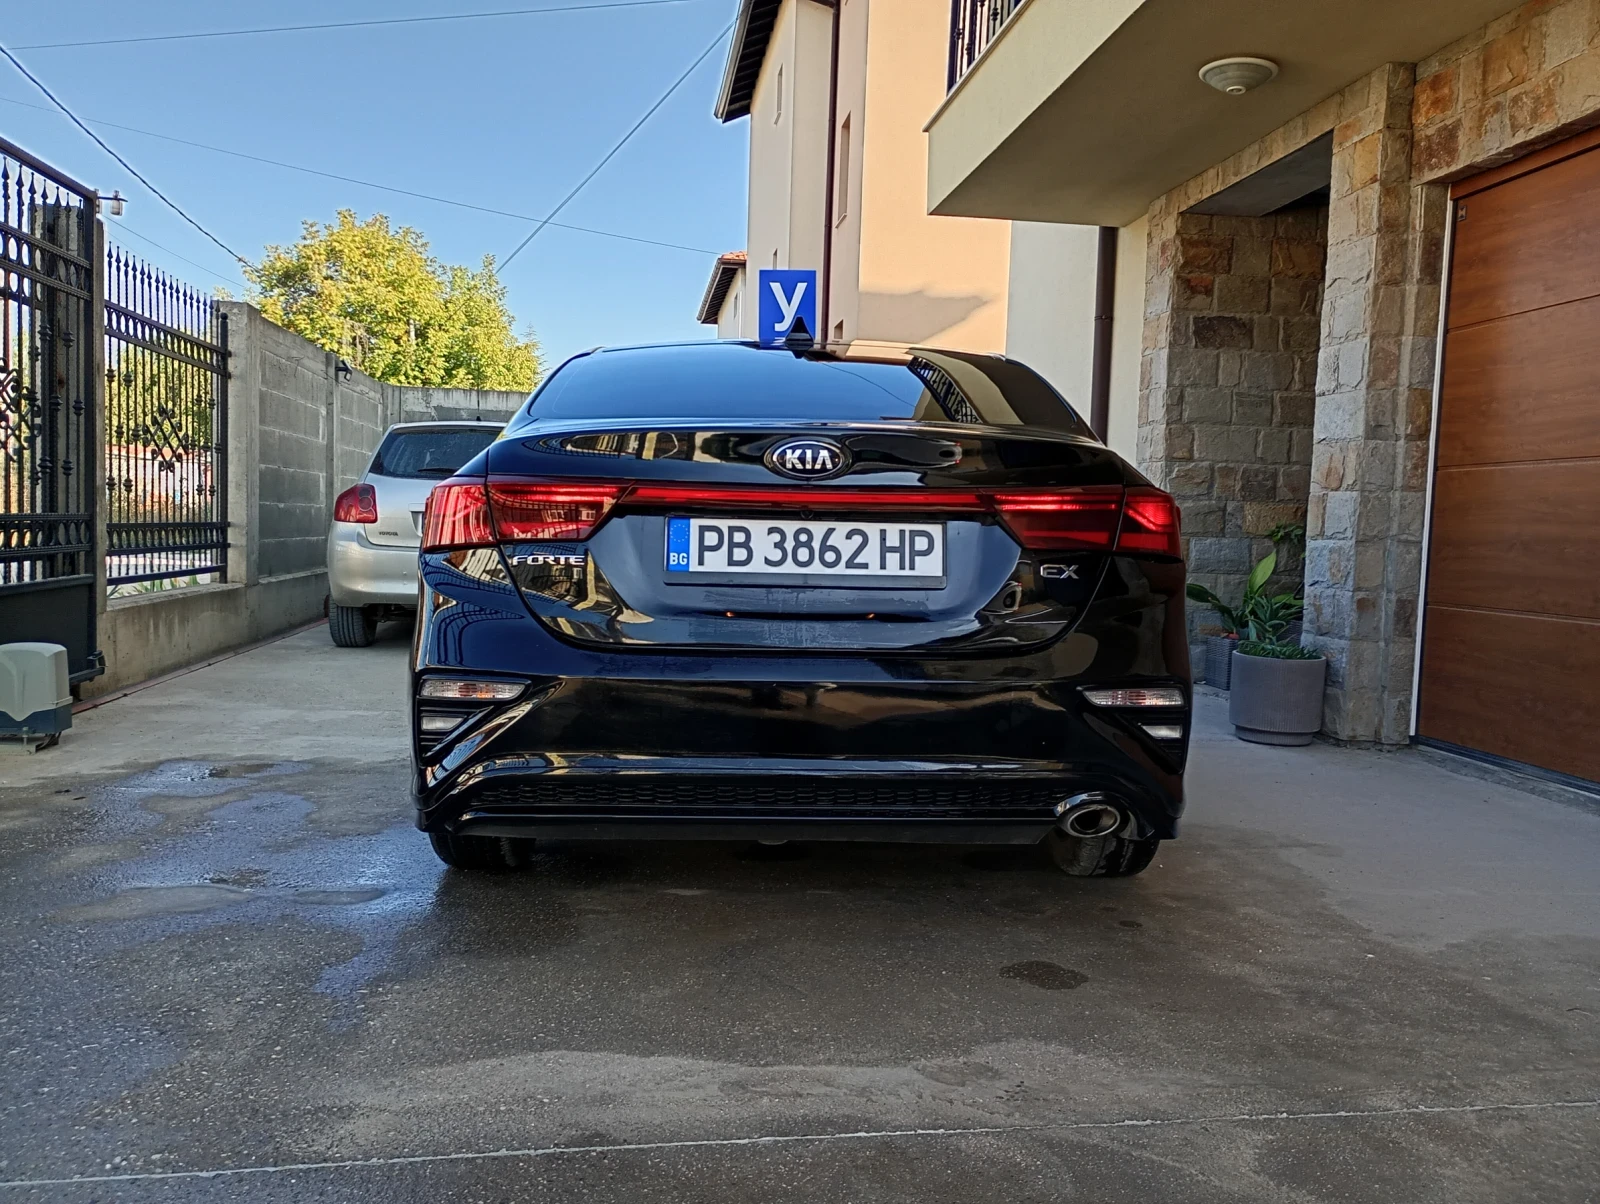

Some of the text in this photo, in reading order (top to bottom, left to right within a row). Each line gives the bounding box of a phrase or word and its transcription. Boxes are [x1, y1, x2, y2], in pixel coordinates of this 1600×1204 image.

[785, 448, 832, 470] KIA
[697, 525, 935, 571] PB 3862 HP
[512, 555, 585, 566] FORTE
[669, 553, 688, 565] BG
[1040, 564, 1079, 579] EX
